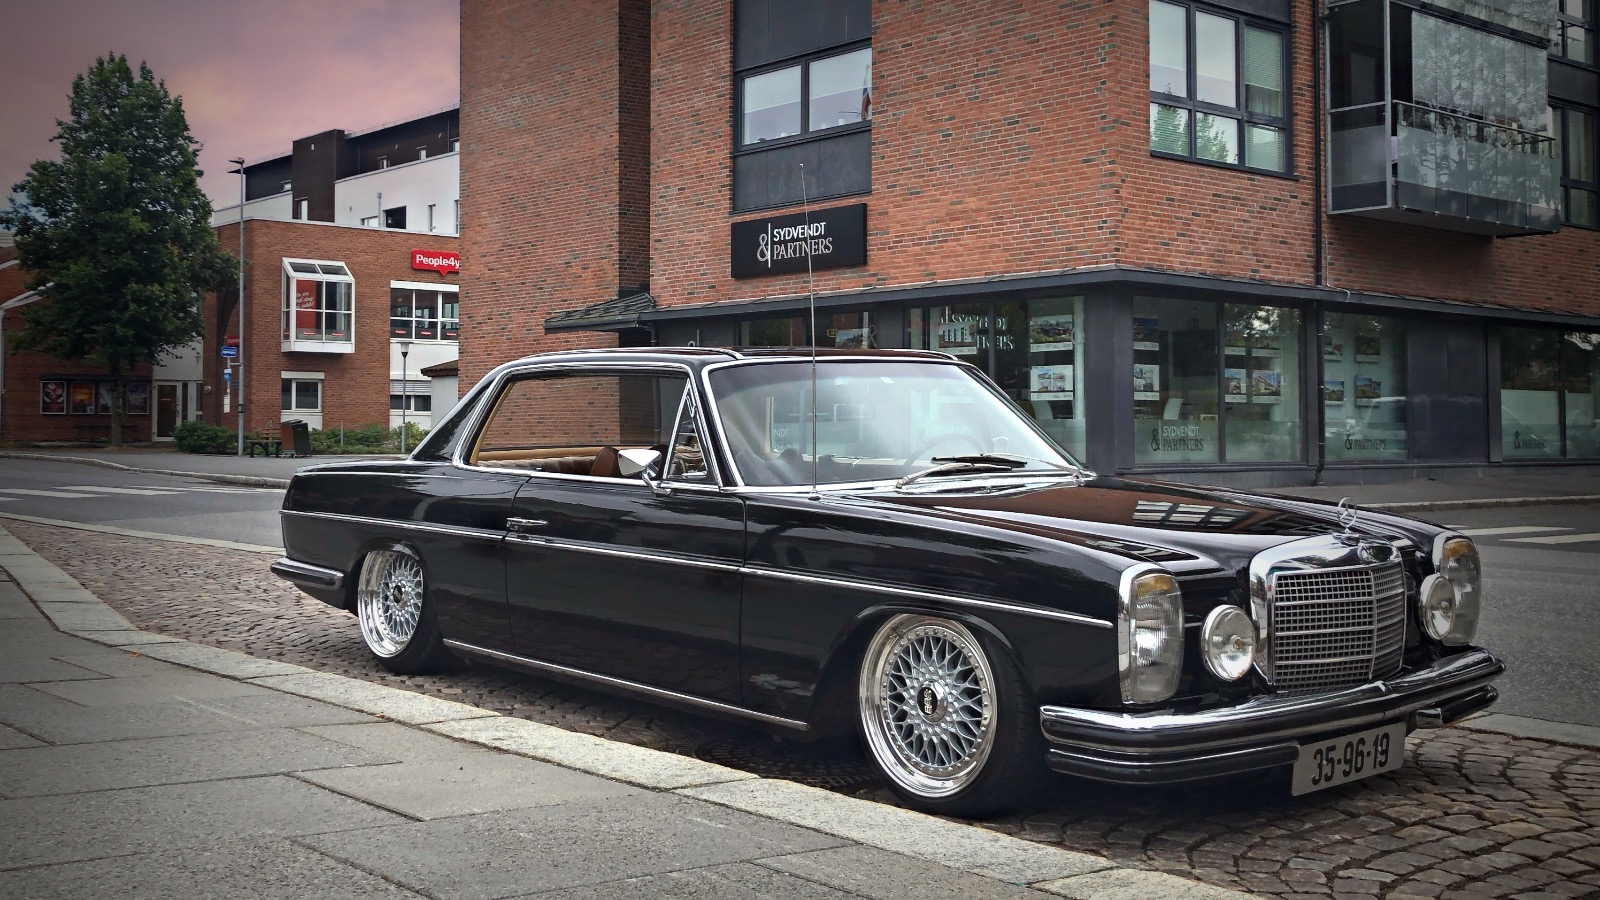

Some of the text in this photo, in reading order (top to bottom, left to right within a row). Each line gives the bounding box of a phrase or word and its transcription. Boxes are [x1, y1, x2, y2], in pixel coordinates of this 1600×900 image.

[773, 222, 826, 241] SYDVENDT
[756, 233, 833, 261] & PARTNERS
[1163, 425, 1199, 437] SYDVENDT
[1163, 438, 1204, 452] PARTNERS
[1311, 732, 1390, 785] 35-96-19
